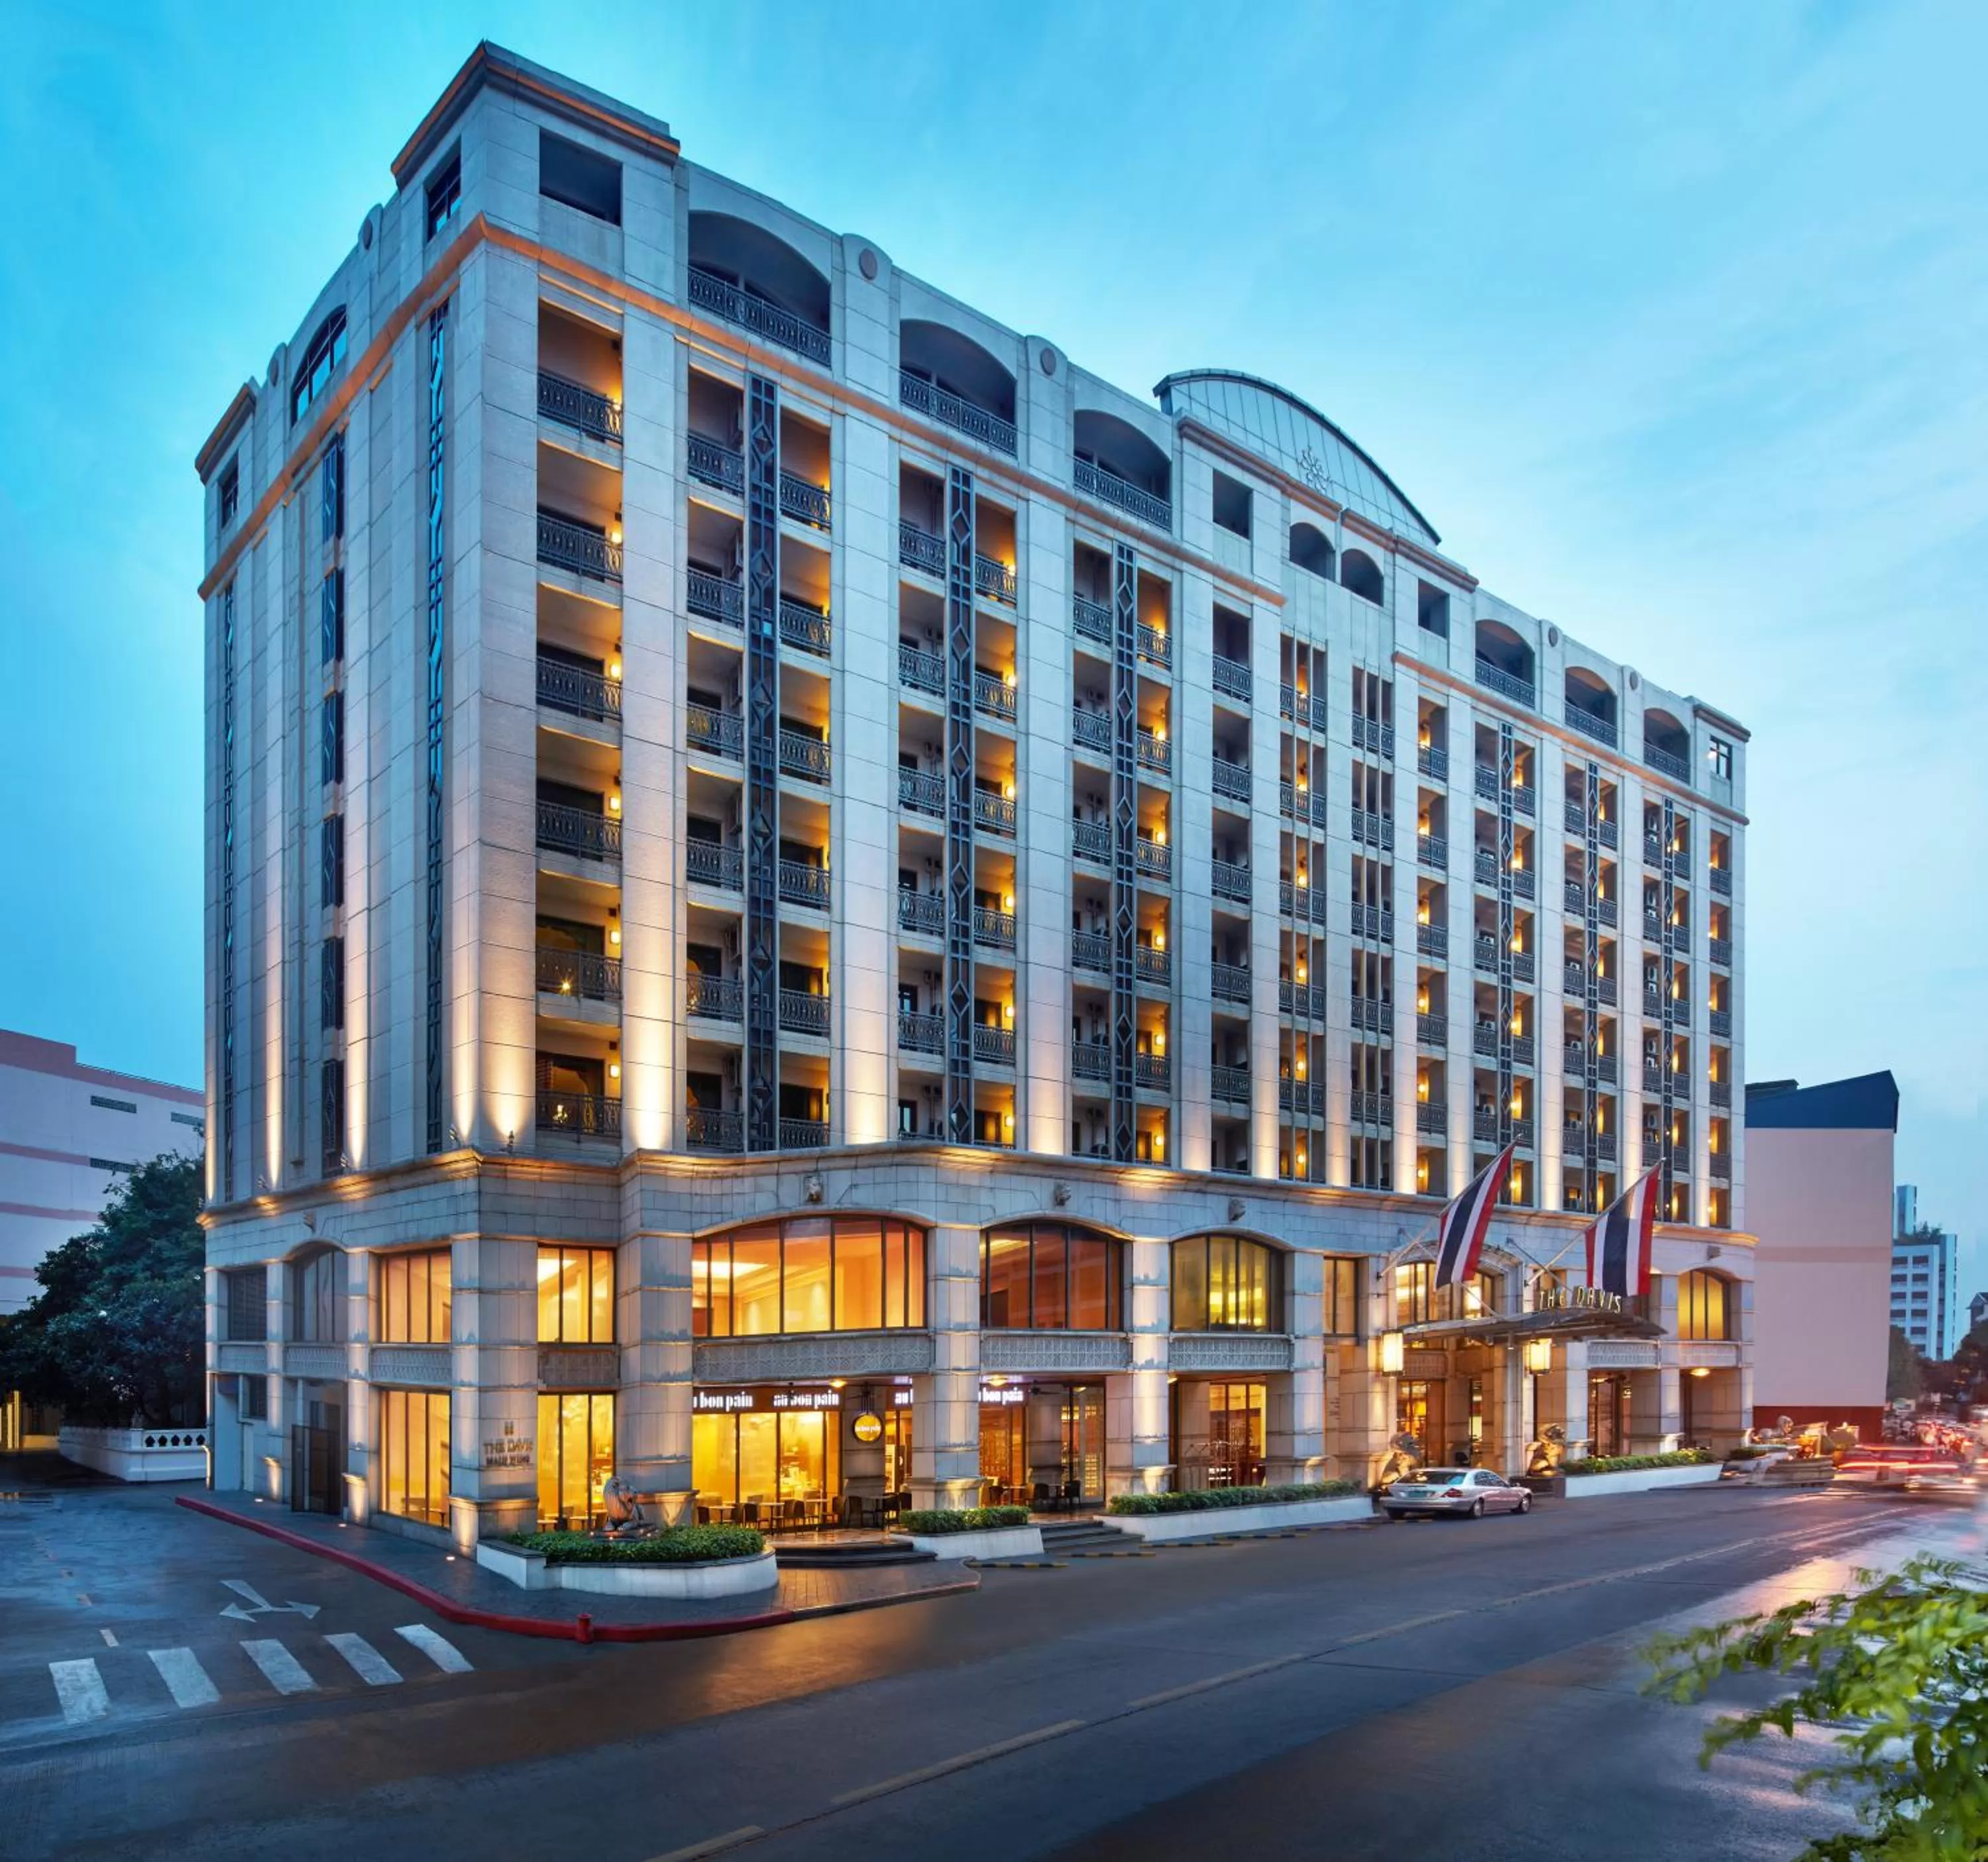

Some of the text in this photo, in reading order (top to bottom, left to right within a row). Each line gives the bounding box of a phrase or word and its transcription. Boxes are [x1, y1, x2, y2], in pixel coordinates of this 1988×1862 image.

[1574, 1286, 1622, 1315] DAVIS
[700, 1391, 723, 1408] bon
[726, 1391, 753, 1412] pain
[814, 1390, 838, 1410] pain
